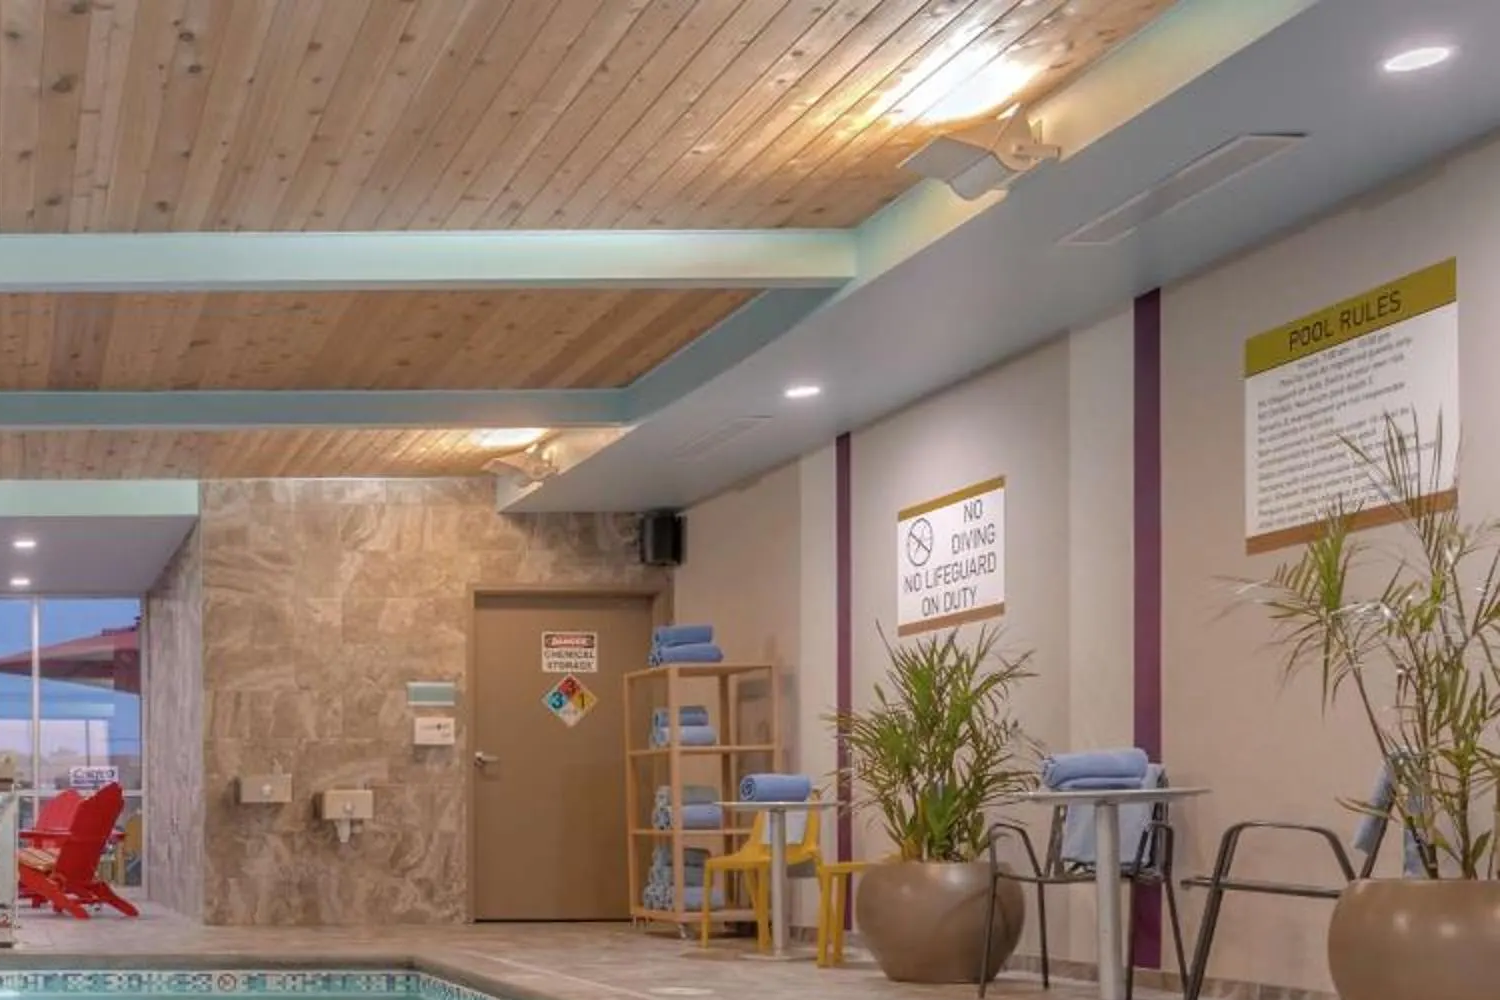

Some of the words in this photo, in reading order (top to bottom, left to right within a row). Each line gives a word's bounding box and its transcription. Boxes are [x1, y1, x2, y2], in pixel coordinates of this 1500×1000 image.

[1289, 320, 1334, 352] POOL
[1340, 290, 1401, 332] RULES
[964, 499, 982, 522] NO
[951, 523, 995, 554] DIVING
[904, 572, 922, 594] NO
[925, 552, 996, 589] LIFEGUARD
[922, 596, 939, 616] ON
[943, 586, 977, 612] DUTY
